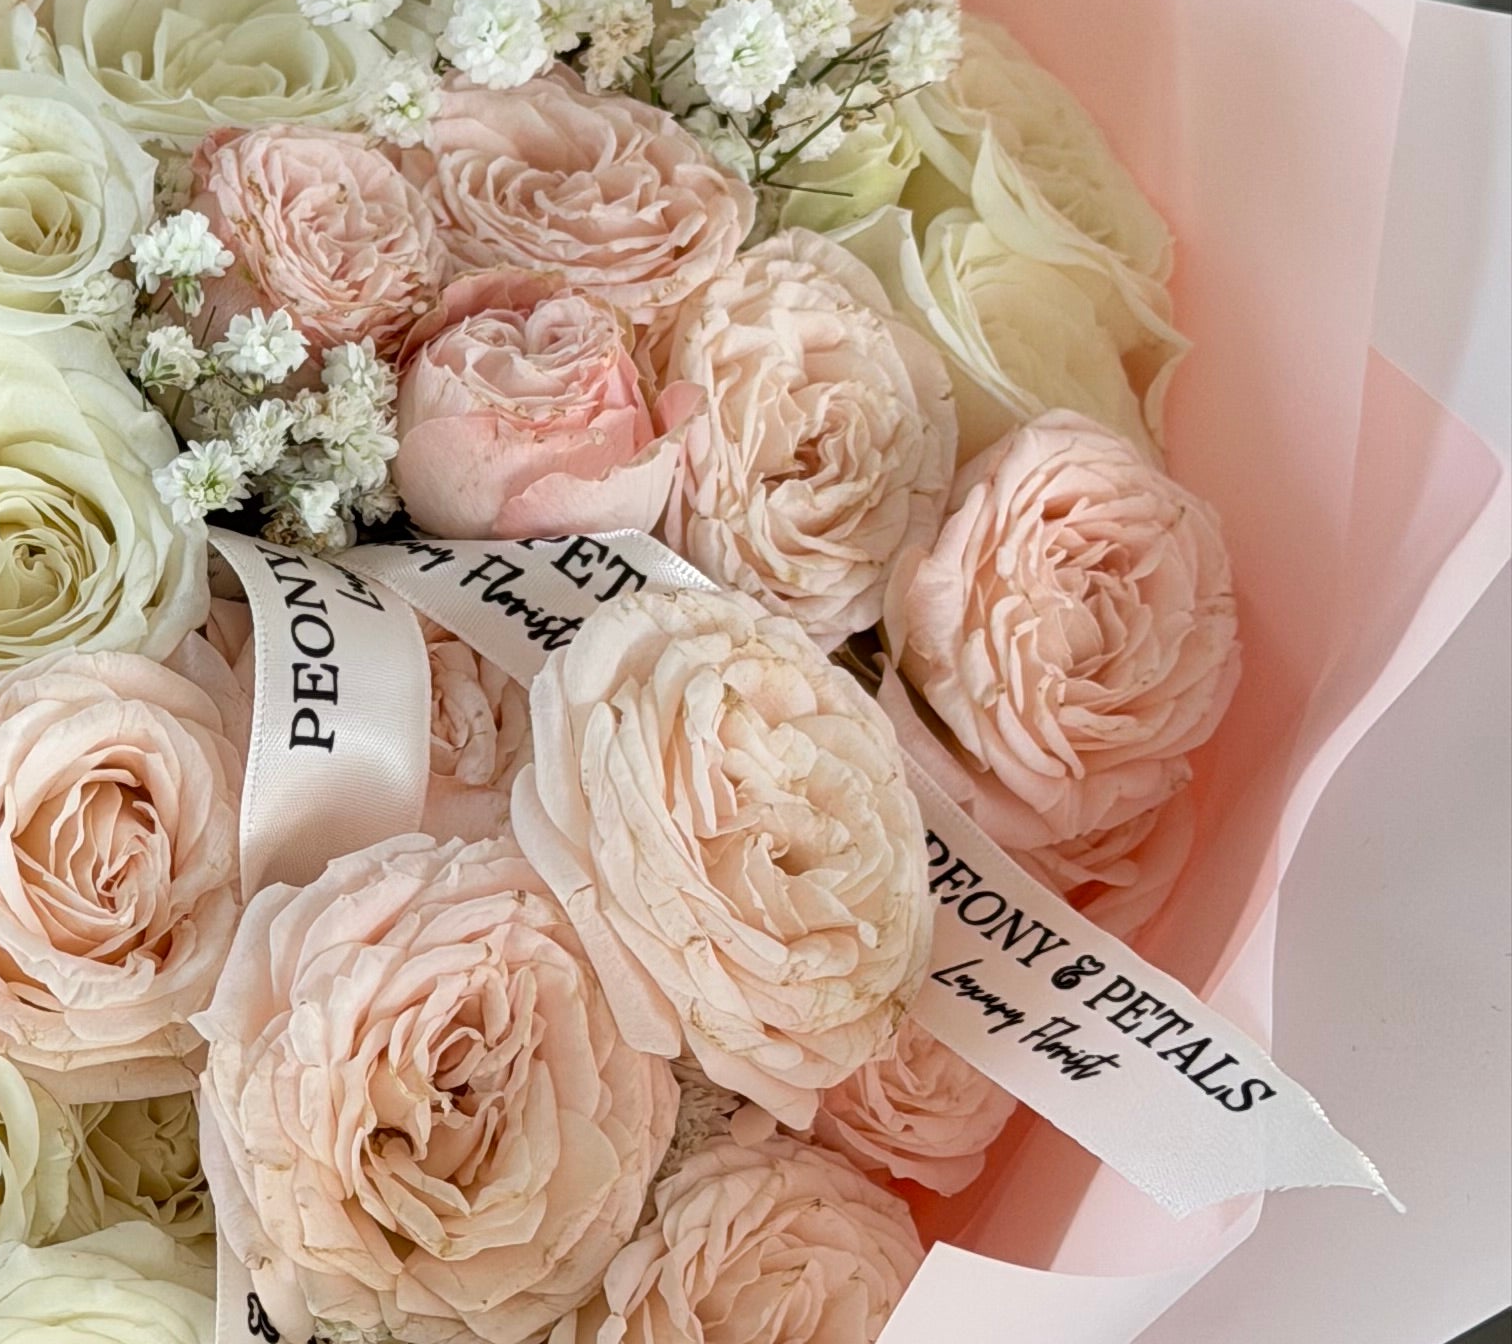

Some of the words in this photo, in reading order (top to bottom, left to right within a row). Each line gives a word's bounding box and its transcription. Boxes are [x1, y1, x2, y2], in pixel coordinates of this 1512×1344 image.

[255, 544, 339, 753] PEONY
[460, 553, 584, 651] Florist
[931, 958, 1024, 1034] Luxury
[1018, 1016, 1122, 1081] Florist
[1051, 954, 1105, 990] &
[1084, 975, 1277, 1113] PETALS
